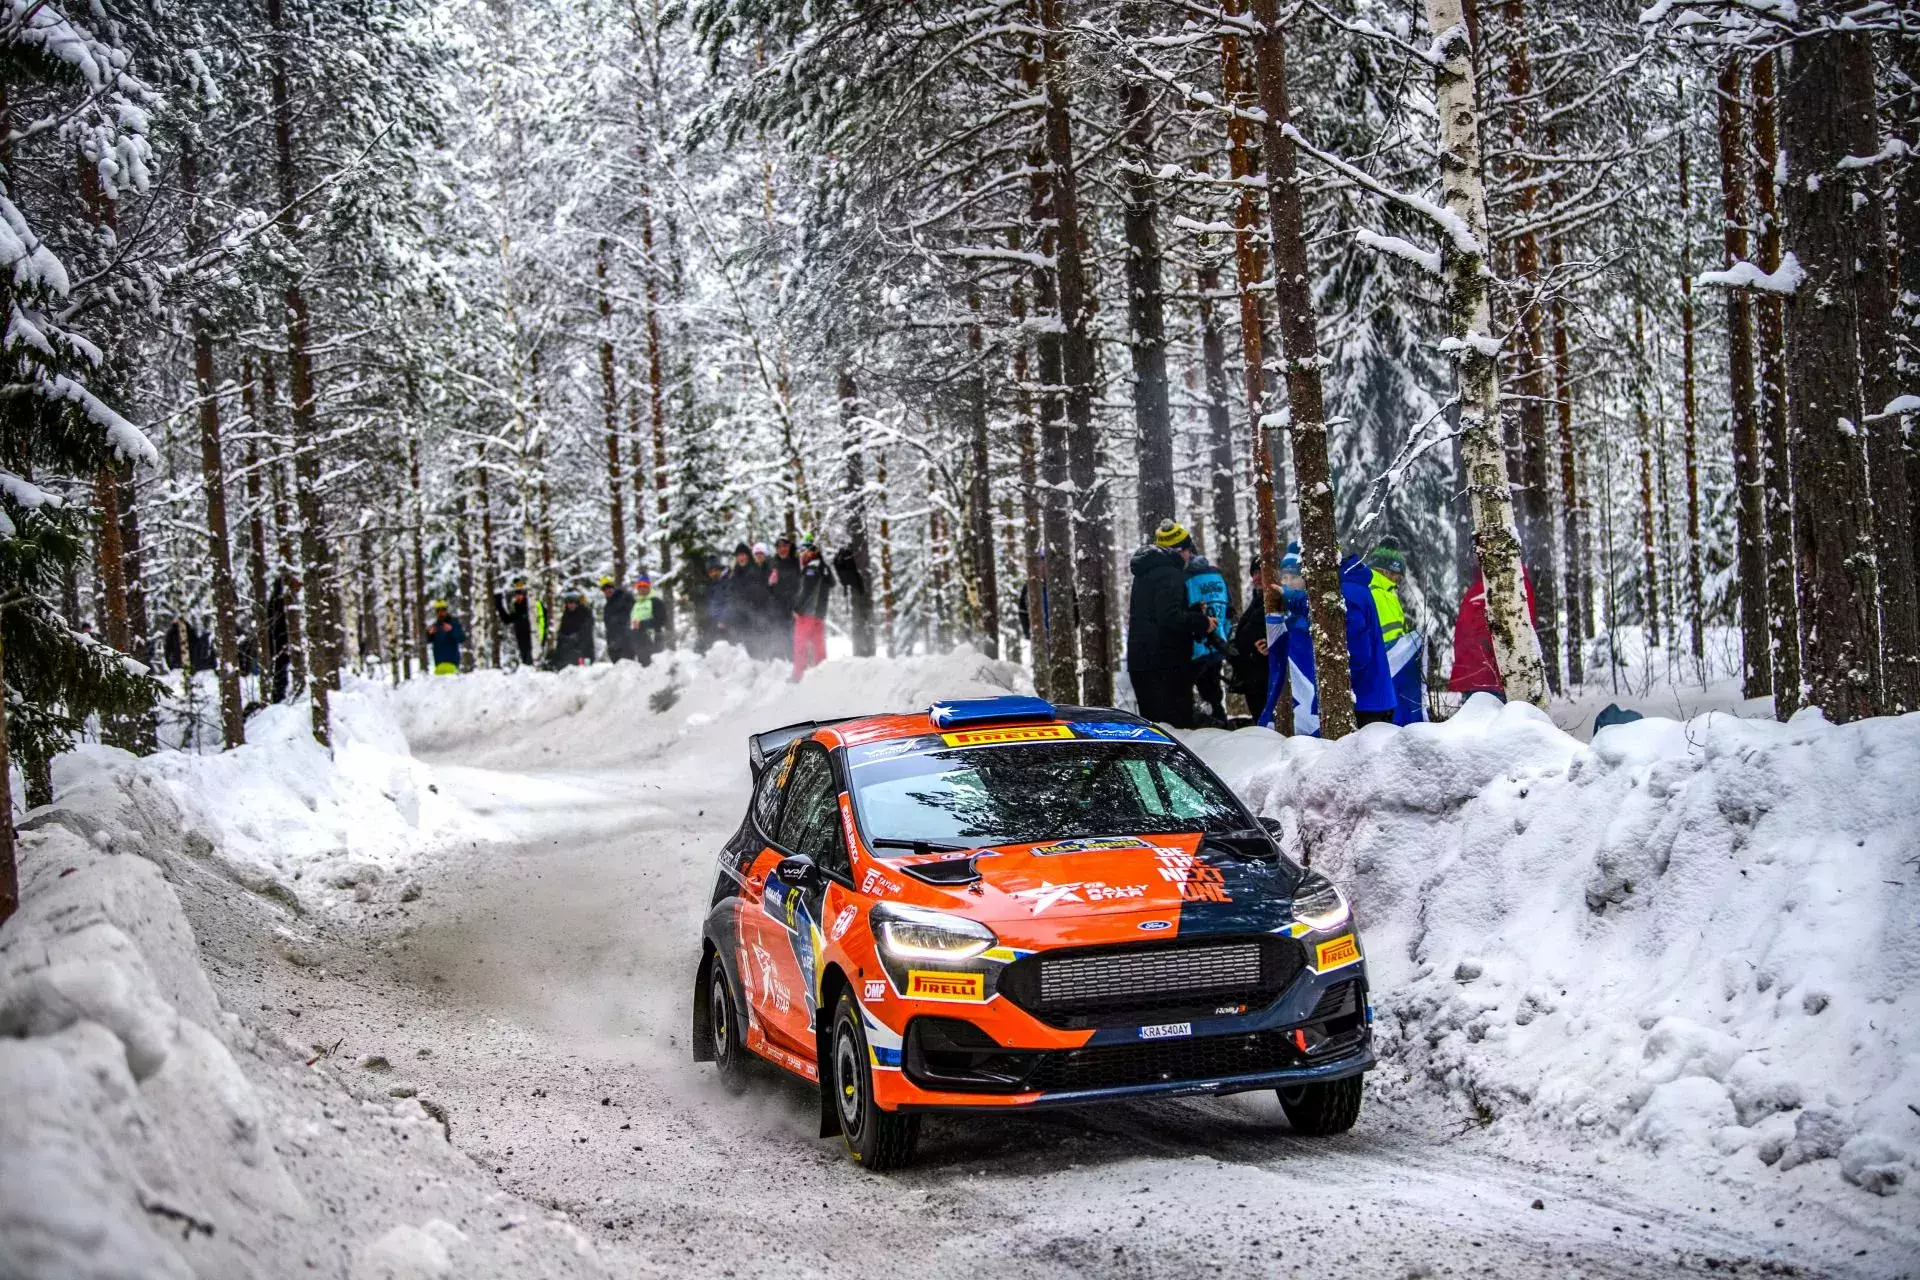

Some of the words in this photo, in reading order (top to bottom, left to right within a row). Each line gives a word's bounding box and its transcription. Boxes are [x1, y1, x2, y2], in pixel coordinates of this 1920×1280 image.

[955, 728, 1060, 743] PIRELLI
[1039, 844, 1080, 853] RALLY
[1152, 848, 1191, 856] BE
[1154, 857, 1209, 867] THE
[1157, 868, 1225, 882] NEXT
[879, 876, 901, 893] TAYLOR
[1177, 882, 1233, 902] ONE
[1322, 939, 1355, 965] PIRELLI
[864, 983, 886, 998] OMP
[914, 975, 977, 996] PIRELLI
